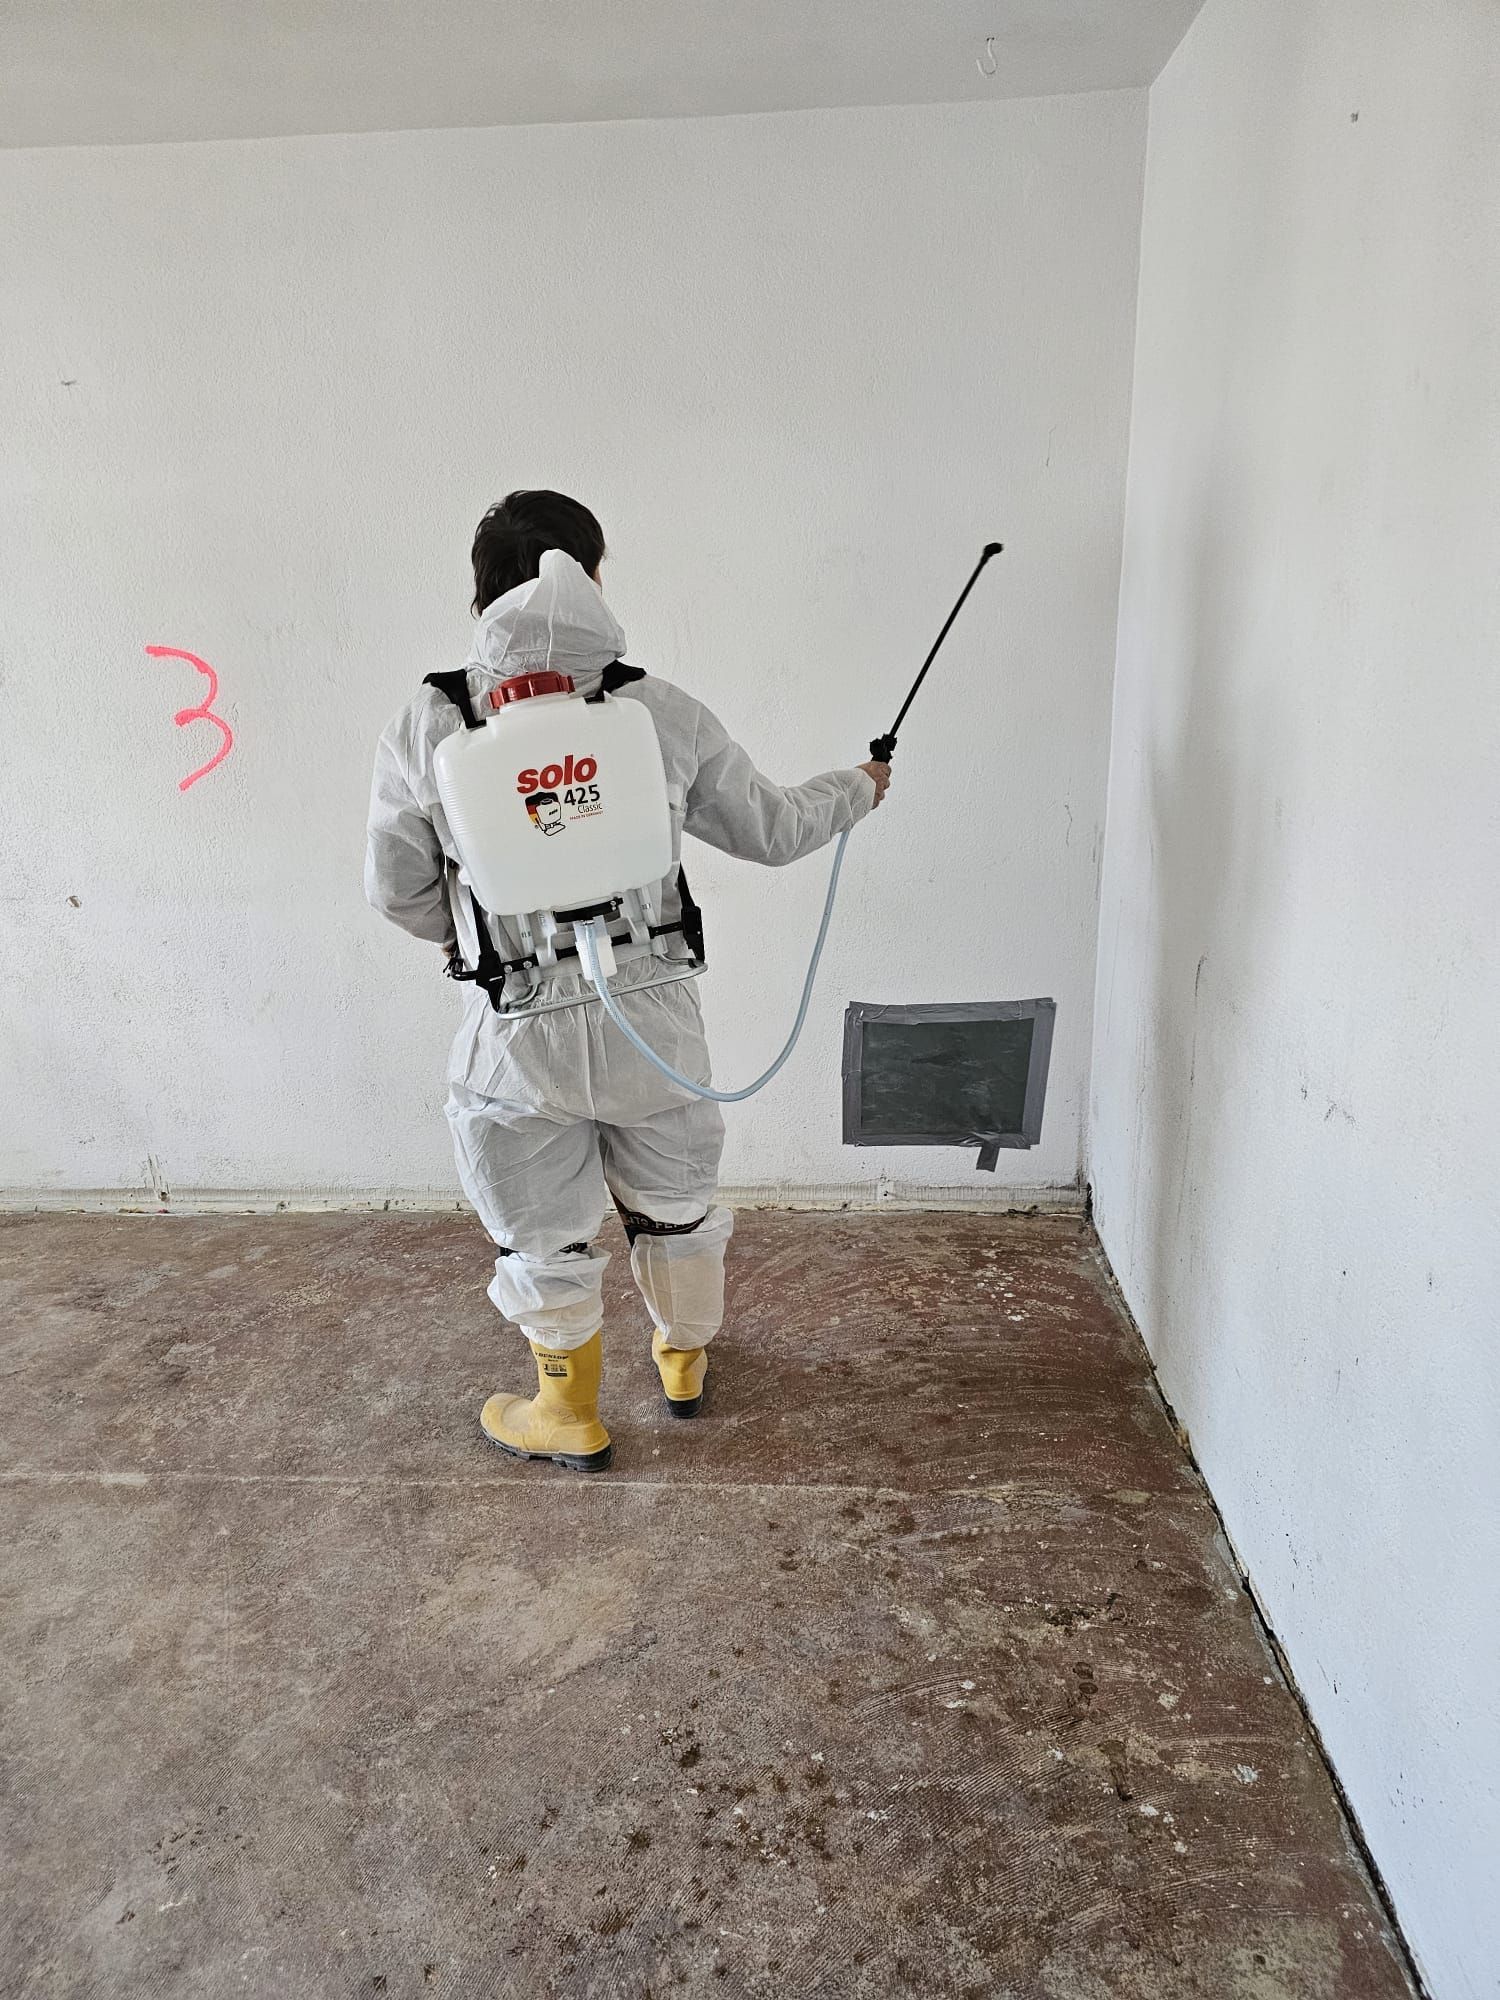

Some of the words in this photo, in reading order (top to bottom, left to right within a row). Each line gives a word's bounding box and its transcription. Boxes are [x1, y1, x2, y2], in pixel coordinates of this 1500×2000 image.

[144, 645, 233, 791] 3
[516, 754, 598, 794] solo
[564, 784, 600, 805] 425
[577, 801, 603, 814] Classic
